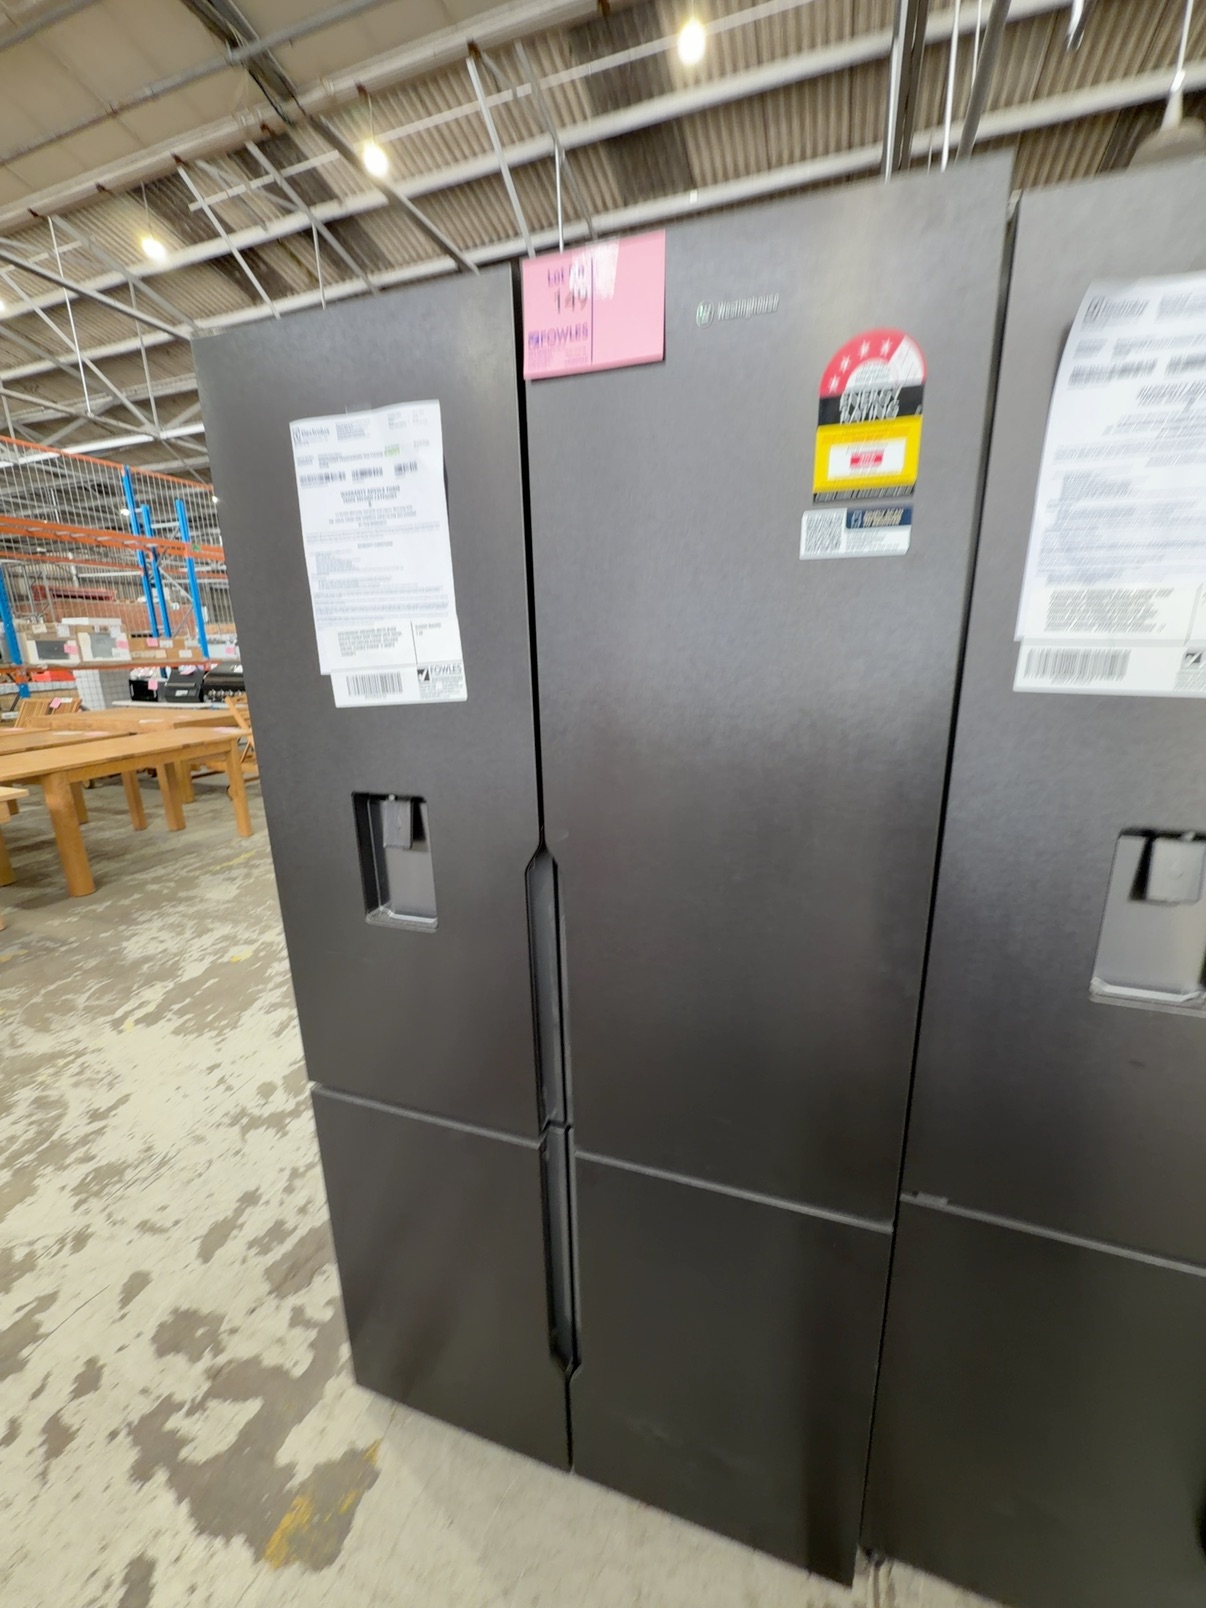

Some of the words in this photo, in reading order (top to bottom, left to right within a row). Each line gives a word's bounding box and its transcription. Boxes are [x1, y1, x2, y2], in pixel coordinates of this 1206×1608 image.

[717, 293, 780, 321] Westinghouse
[540, 323, 589, 347] FOWLES
[840, 384, 903, 412] ENERGY
[839, 399, 900, 426] RATING
[430, 663, 463, 677] FOWLES
